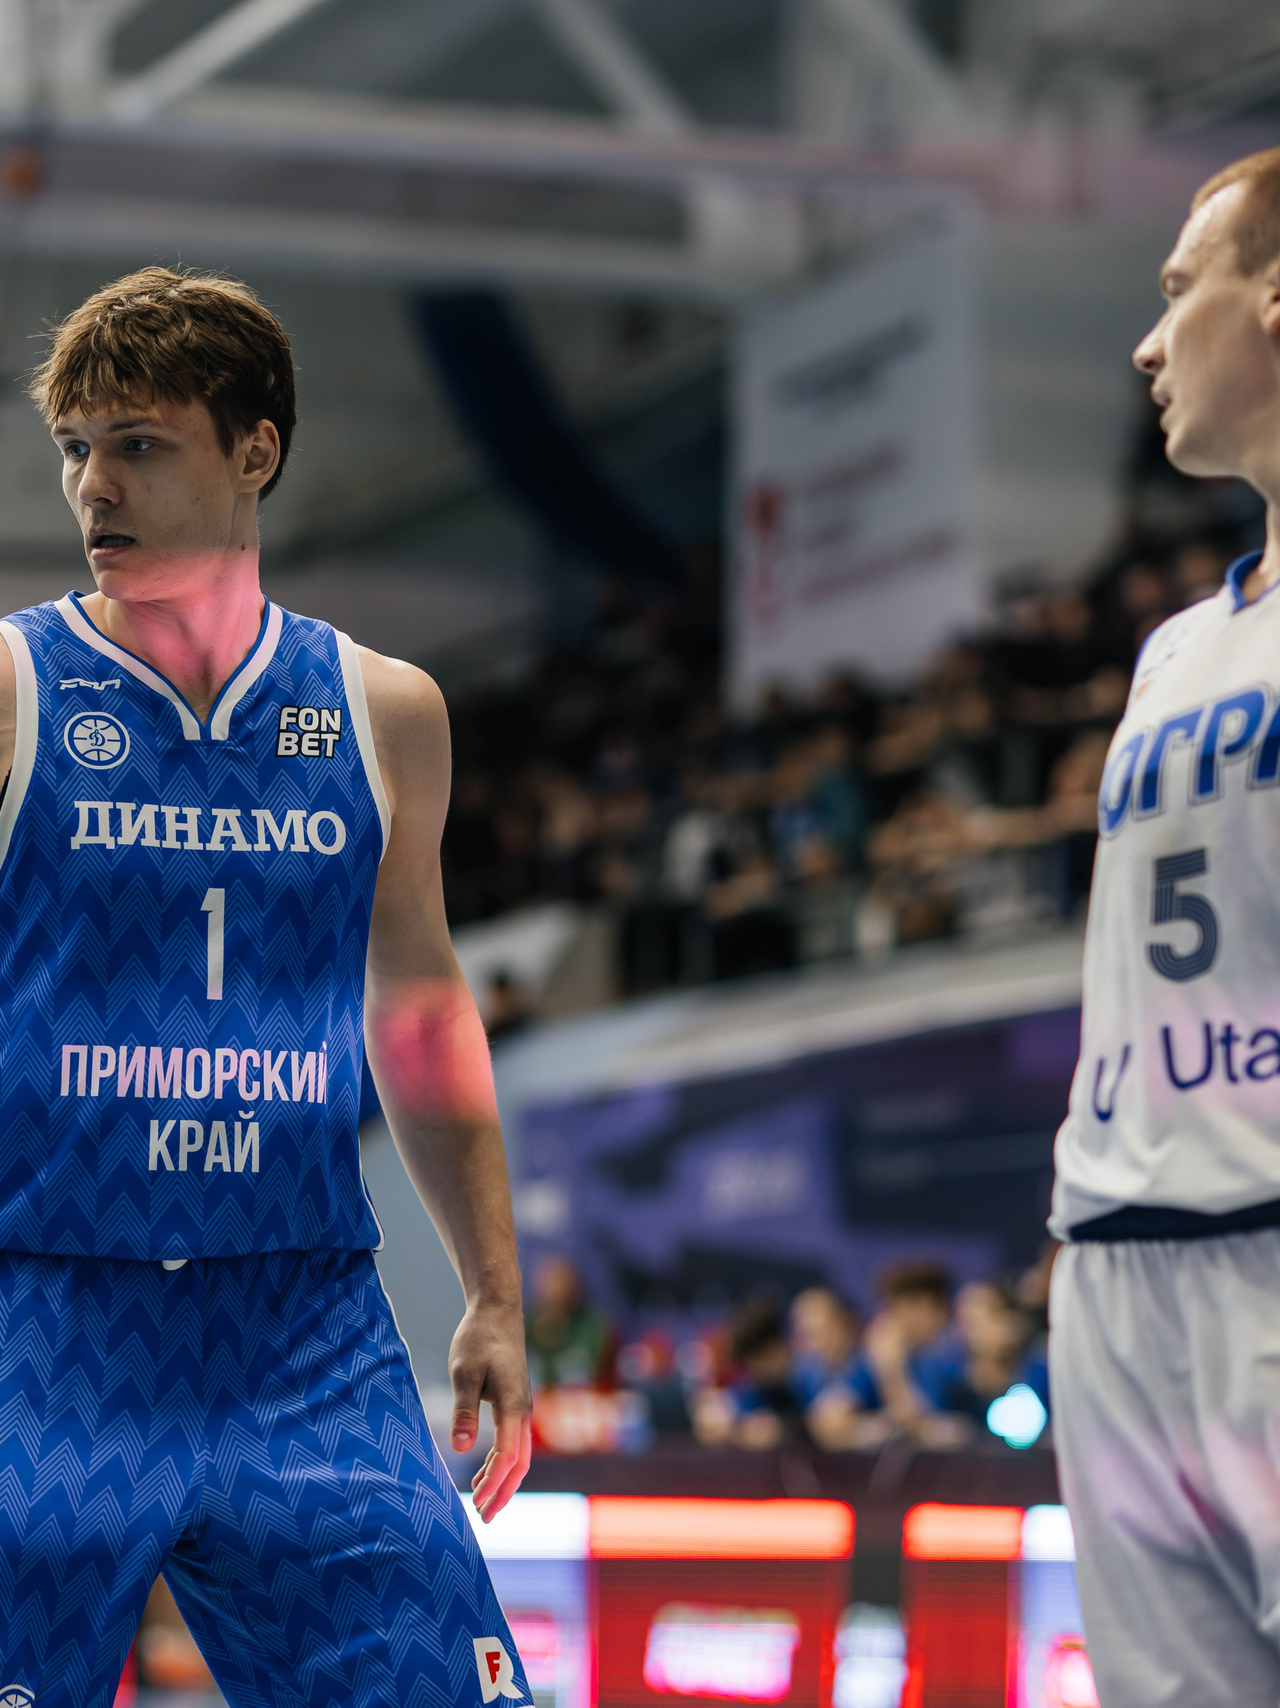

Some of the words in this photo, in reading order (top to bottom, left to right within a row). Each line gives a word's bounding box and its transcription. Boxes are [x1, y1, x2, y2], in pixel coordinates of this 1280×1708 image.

[276, 732, 340, 757] BET
[279, 706, 341, 732] FON
[70, 800, 347, 856] ДИНАМО
[200, 887, 226, 1001] 1
[1149, 847, 1218, 982] 5
[60, 1041, 328, 1105] ПРИМОРСКИЙ
[148, 1110, 260, 1173] КРАЙ
